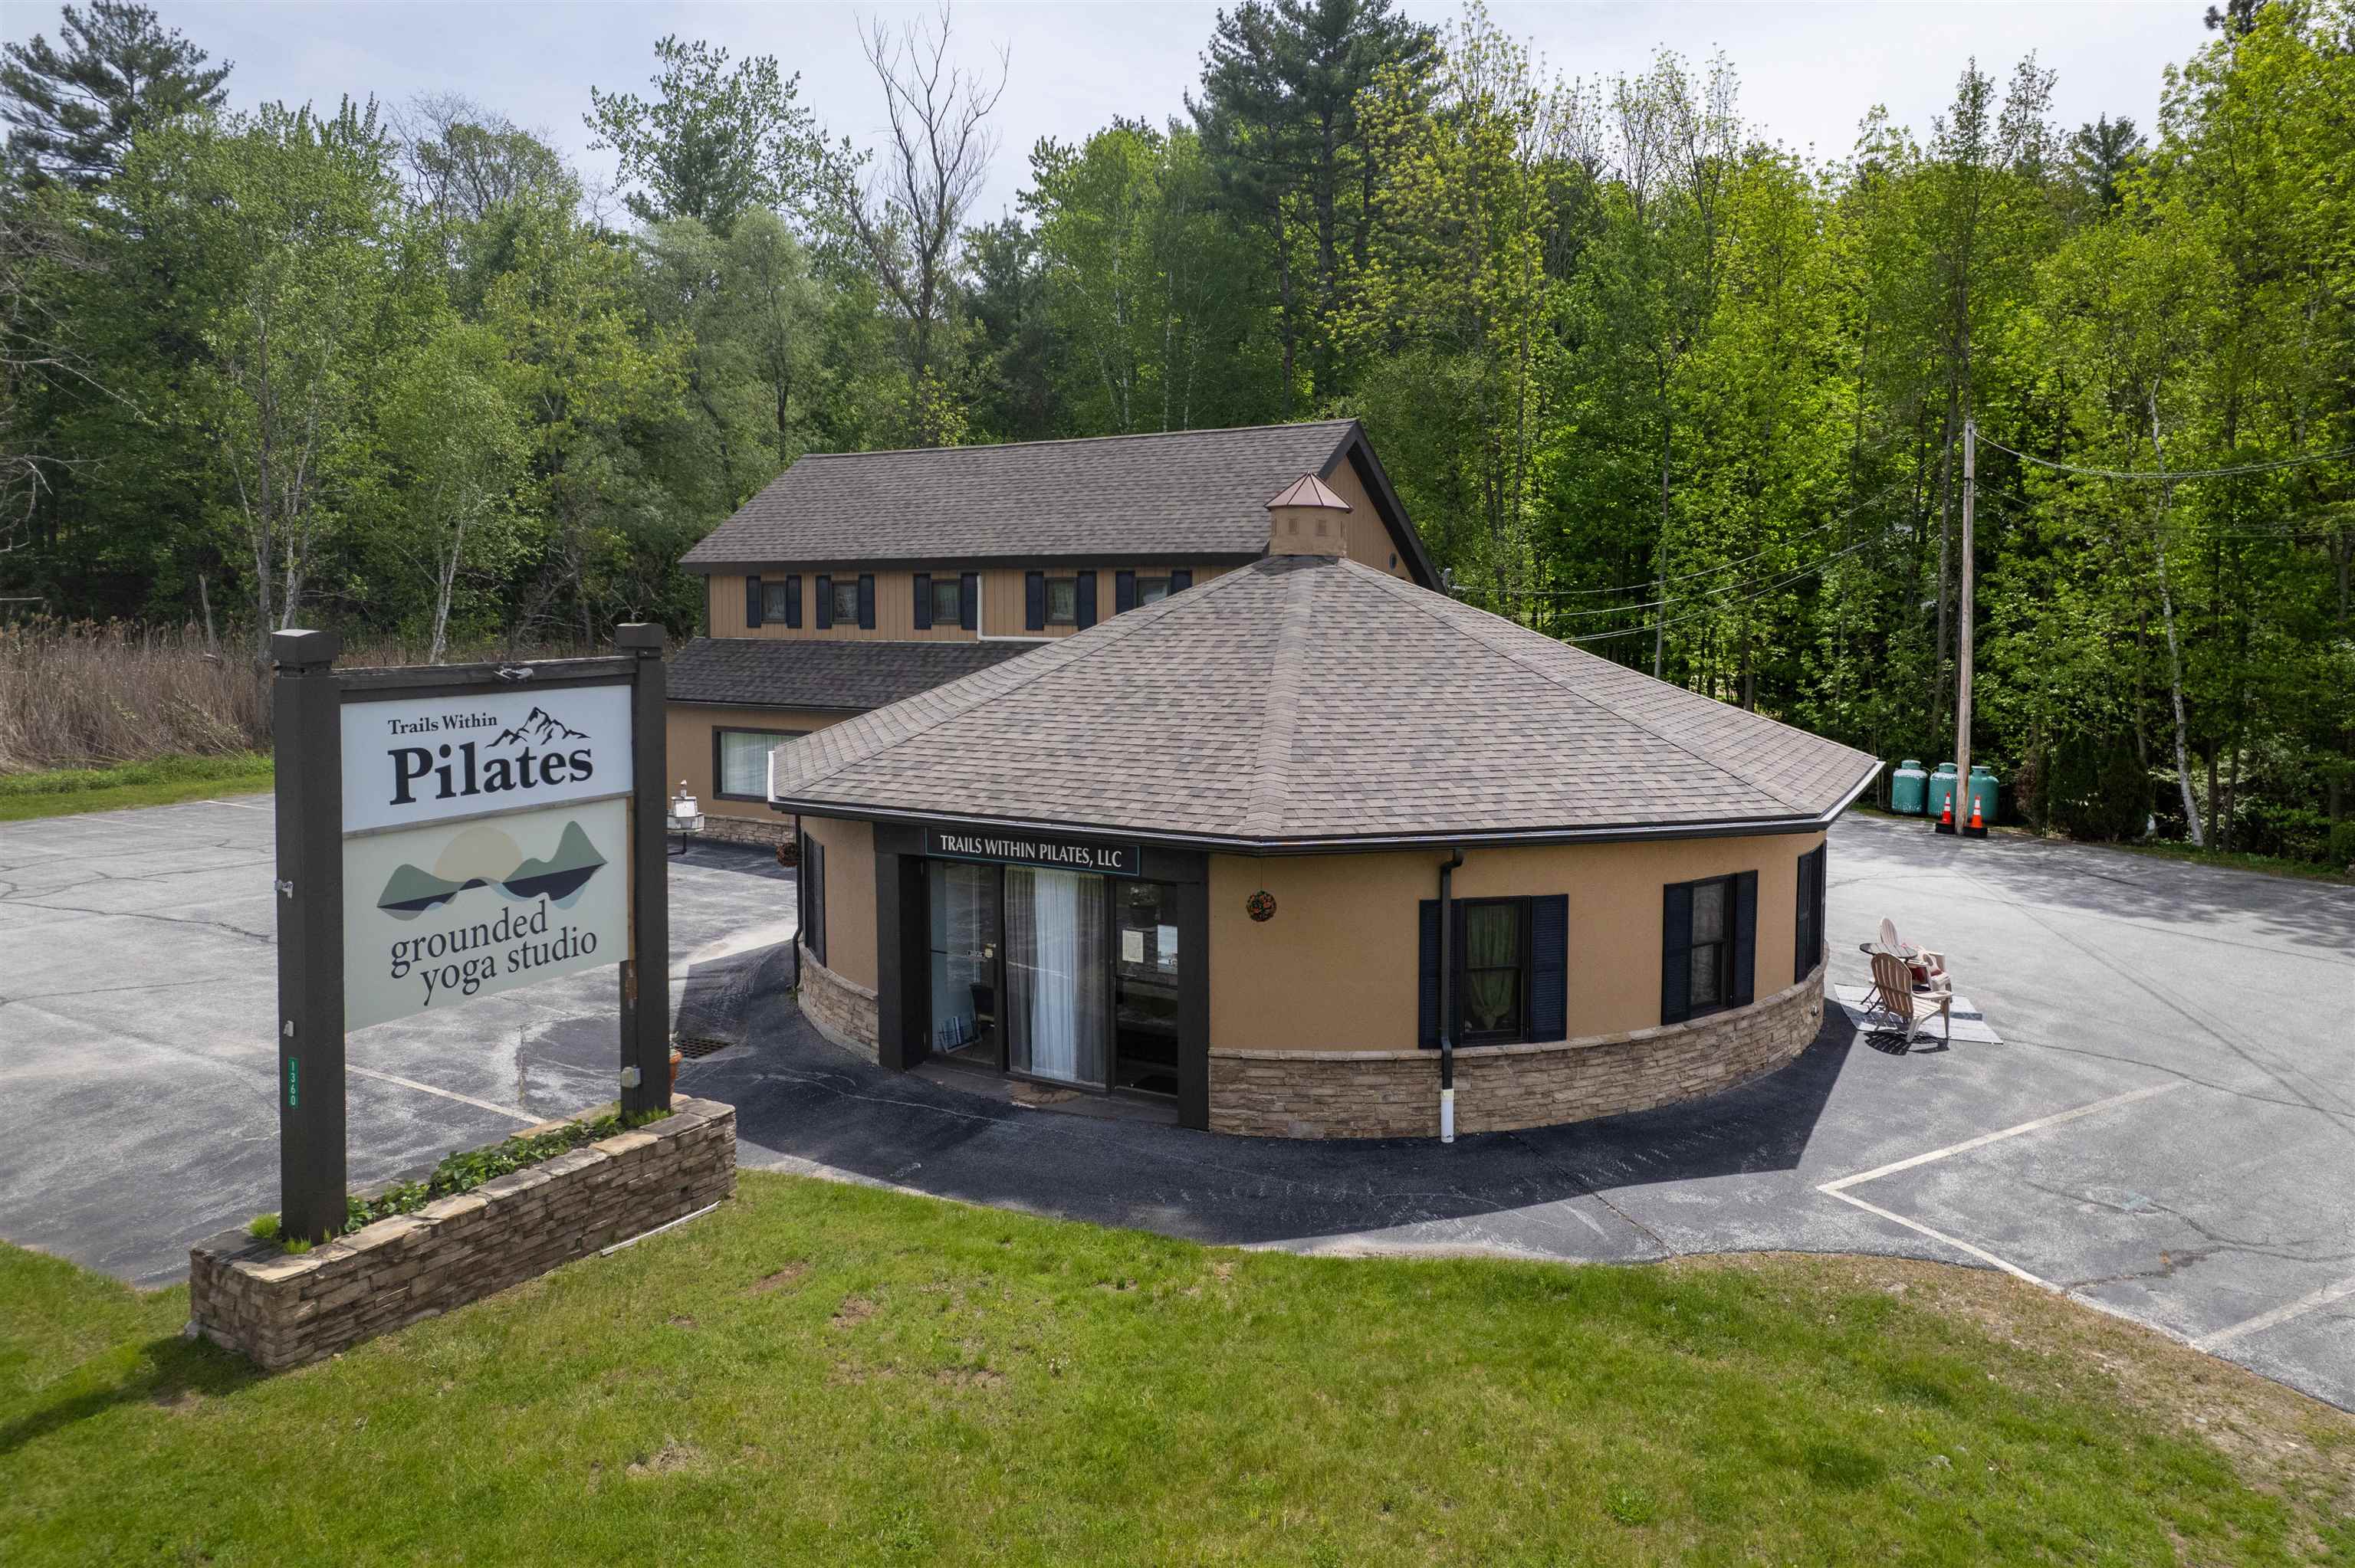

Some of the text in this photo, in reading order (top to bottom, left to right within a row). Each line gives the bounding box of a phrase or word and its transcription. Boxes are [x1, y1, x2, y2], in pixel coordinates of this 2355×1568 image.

[388, 713, 498, 735] Trails Within
[387, 741, 593, 805] Pilates
[940, 835, 1122, 868] TRAILS WITHIN PILATES, LLC
[391, 899, 548, 979] grounded
[420, 927, 597, 1006] yoga studio
